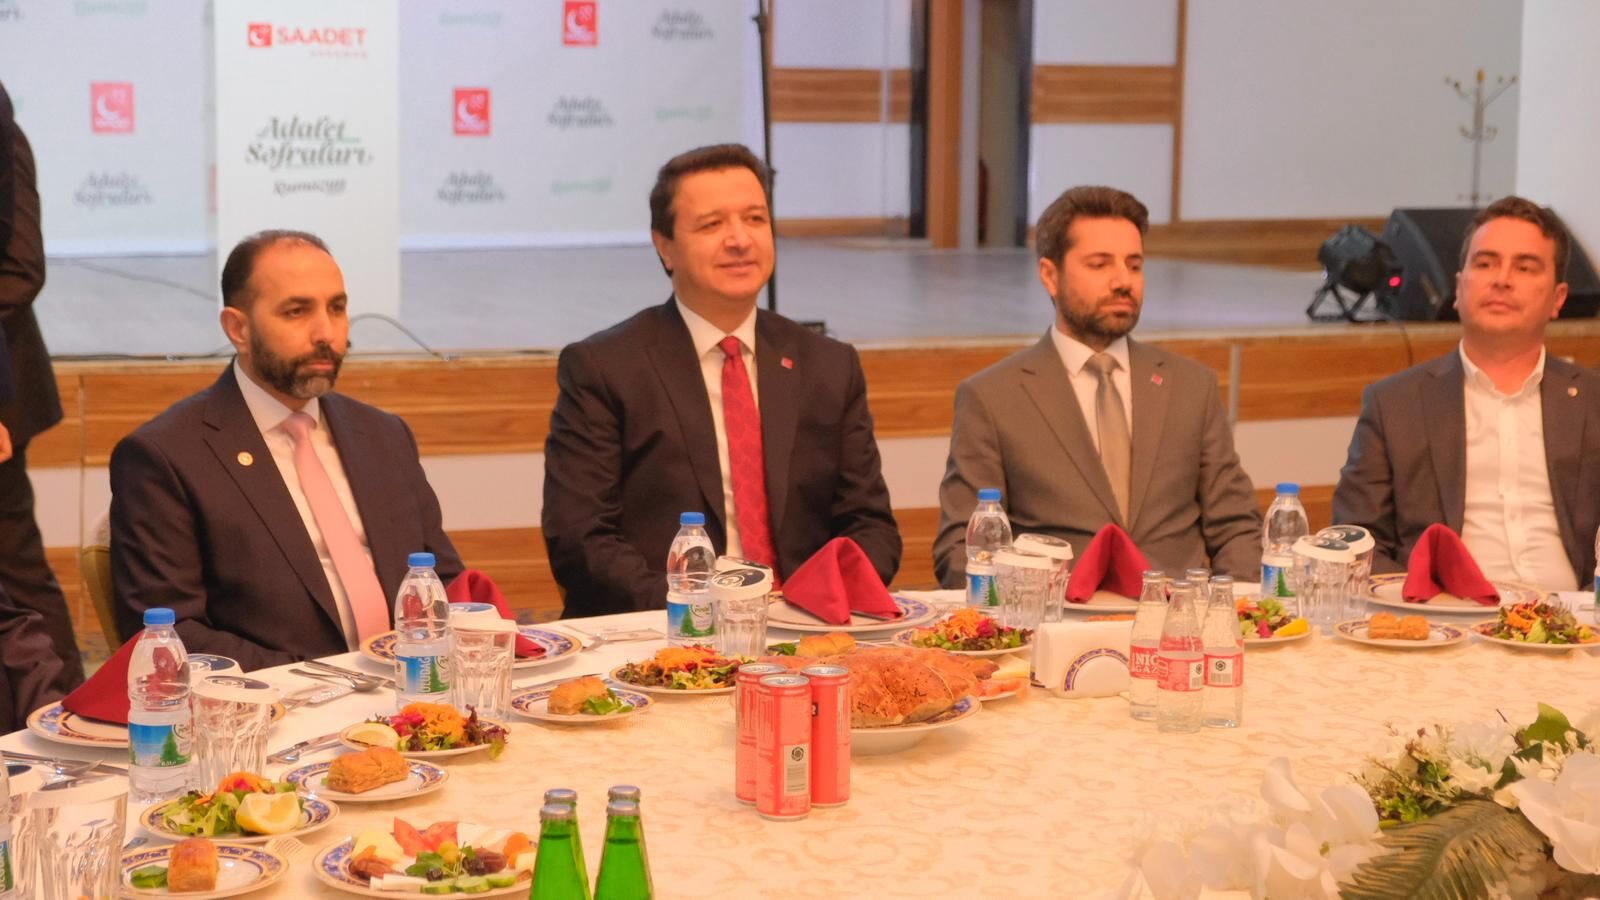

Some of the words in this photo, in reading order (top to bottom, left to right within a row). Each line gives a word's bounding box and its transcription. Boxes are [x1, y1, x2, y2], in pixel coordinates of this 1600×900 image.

[278, 26, 367, 46] SAADET
[257, 115, 350, 140] Adalet
[1135, 665, 1159, 674] GAZ
